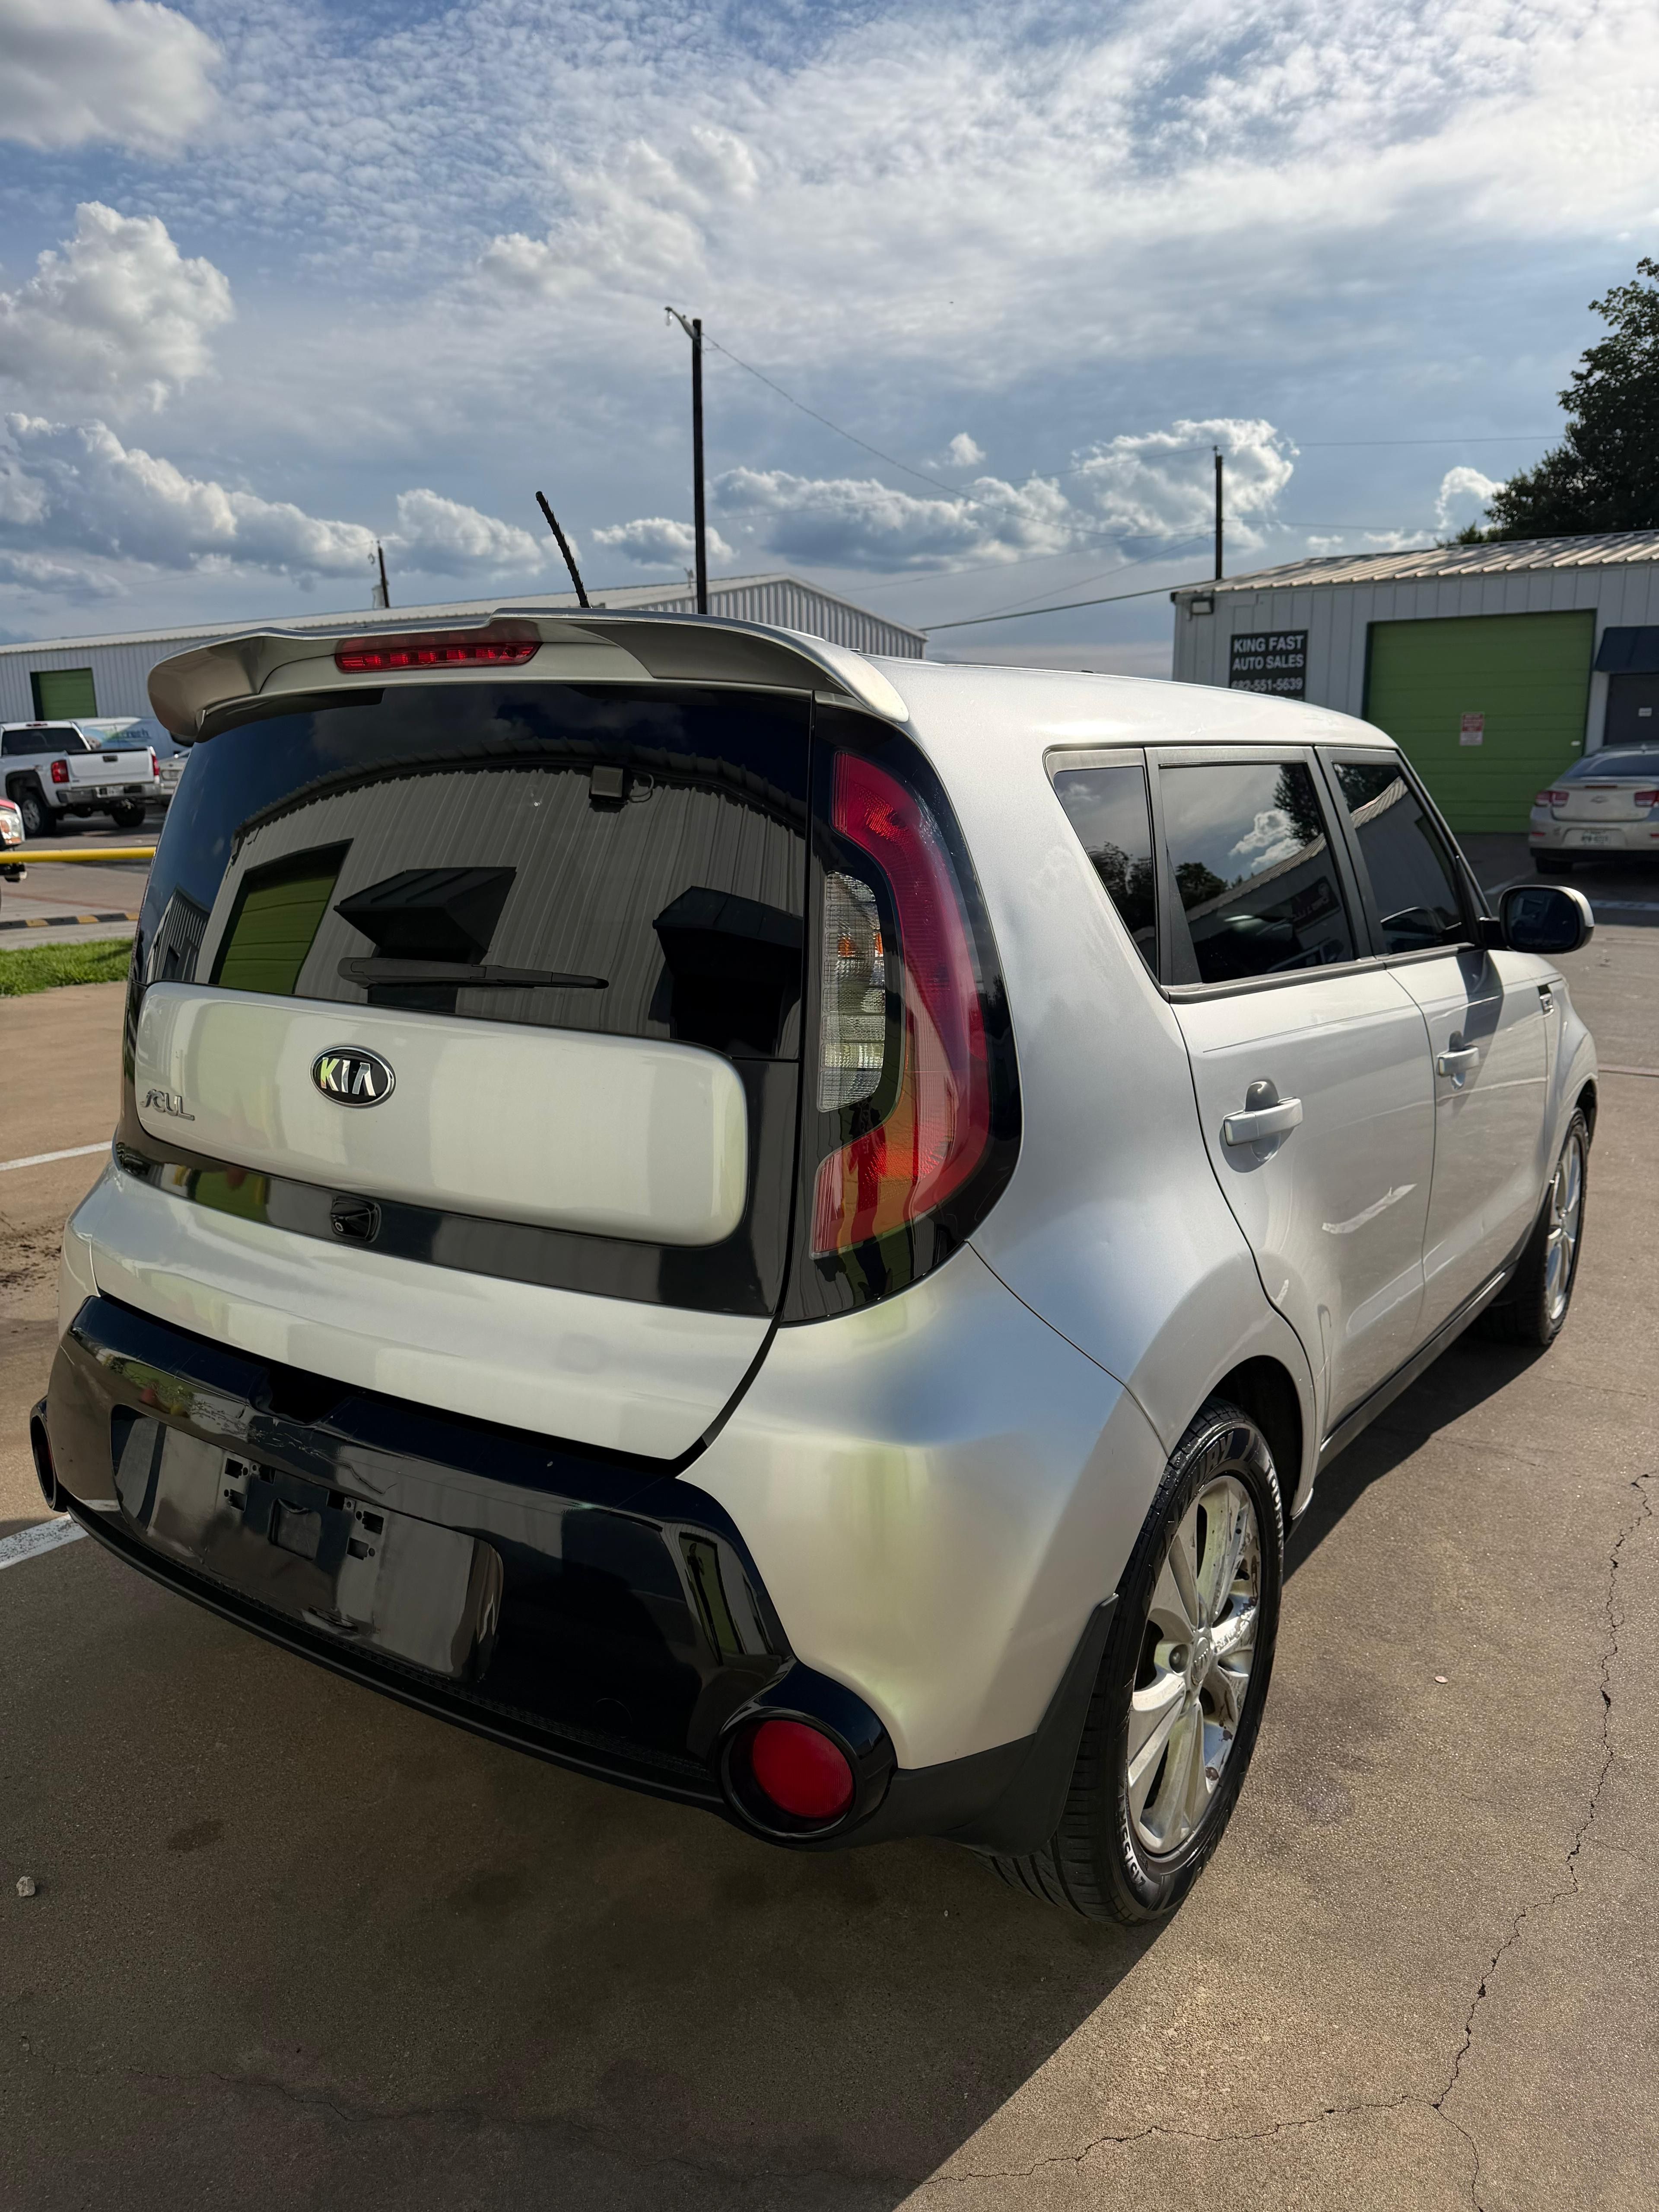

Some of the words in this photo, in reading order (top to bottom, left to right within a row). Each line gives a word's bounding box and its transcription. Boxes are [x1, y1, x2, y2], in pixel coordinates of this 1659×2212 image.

[1233, 637, 1266, 653] KING
[1269, 635, 1304, 651] FAST
[1233, 656, 1264, 671] AUTO
[1266, 653, 1304, 669] SALES
[321, 1057, 377, 1096] KIA
